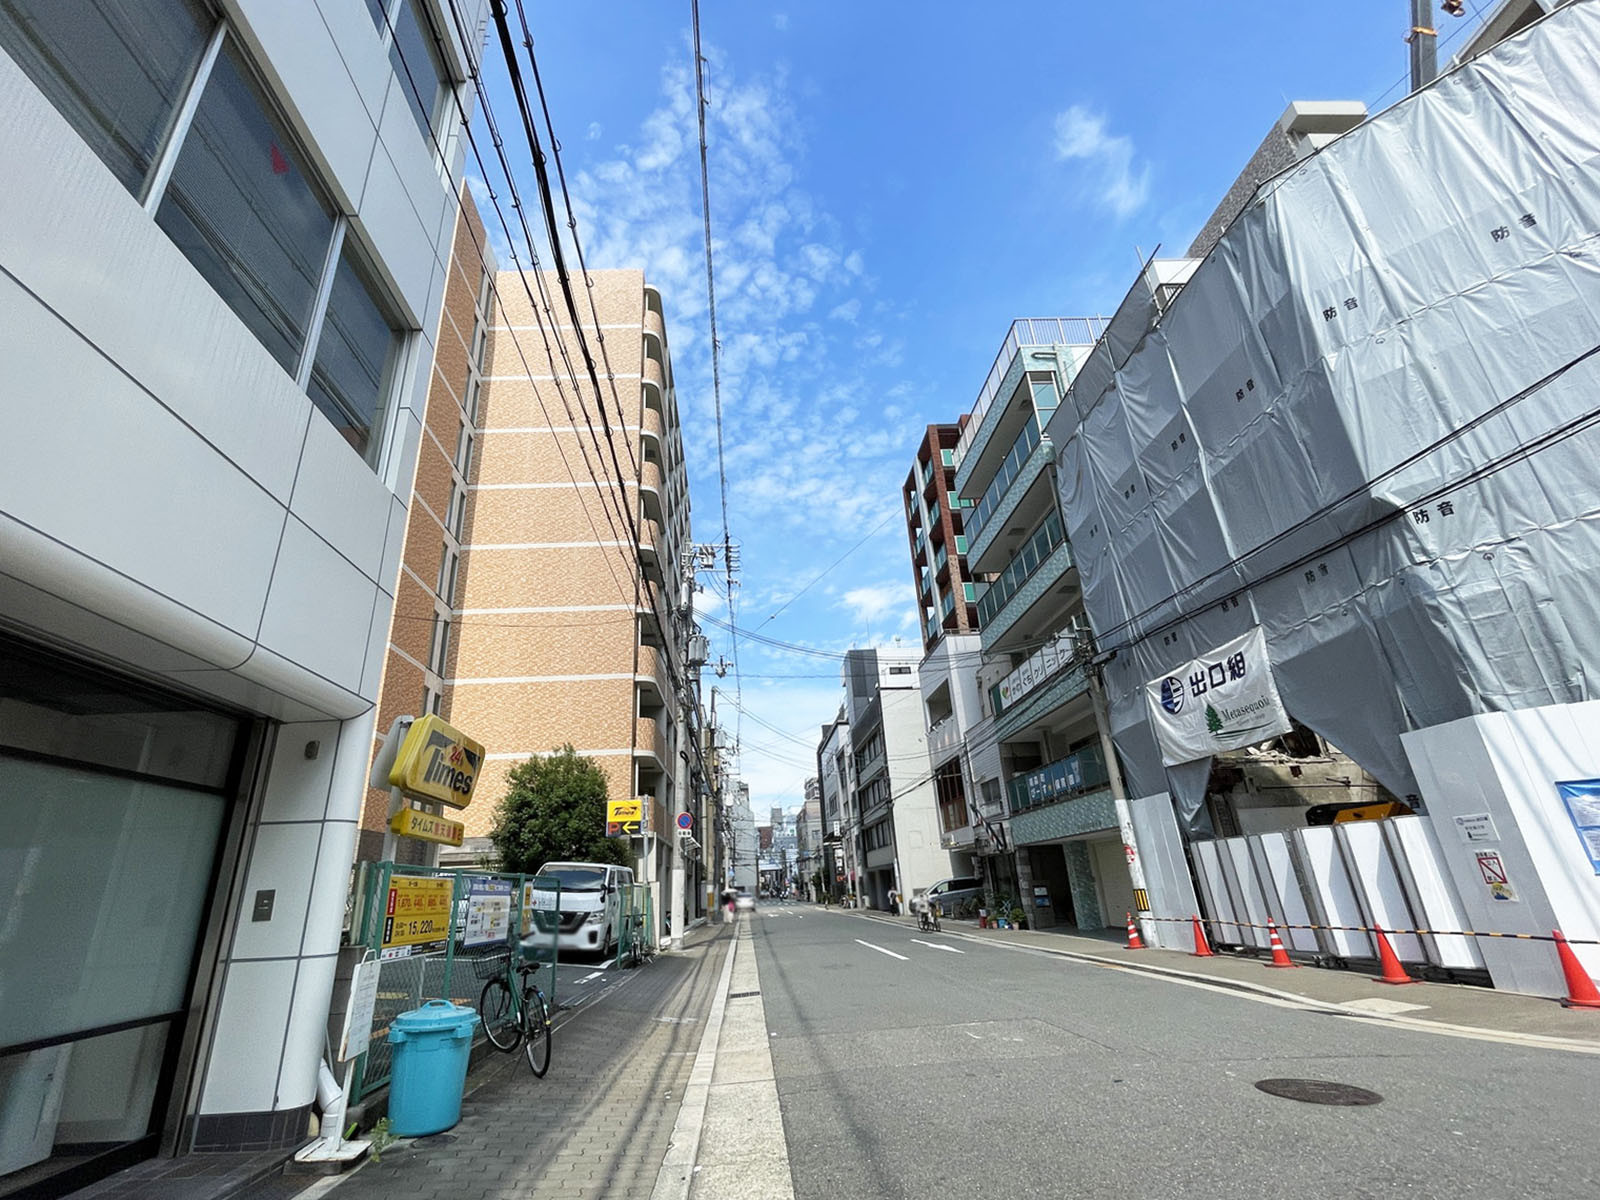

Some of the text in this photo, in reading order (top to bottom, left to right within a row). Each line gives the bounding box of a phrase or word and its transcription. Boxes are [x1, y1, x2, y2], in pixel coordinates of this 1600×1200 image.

[1490, 213, 1537, 242] 防音
[1323, 297, 1358, 322] 防音
[1412, 501, 1454, 524] 防音
[1188, 651, 1246, 698] 出口組
[423, 729, 480, 795] Times
[449, 744, 464, 765] 24
[608, 822, 620, 835] P
[408, 920, 433, 935] 15,220
